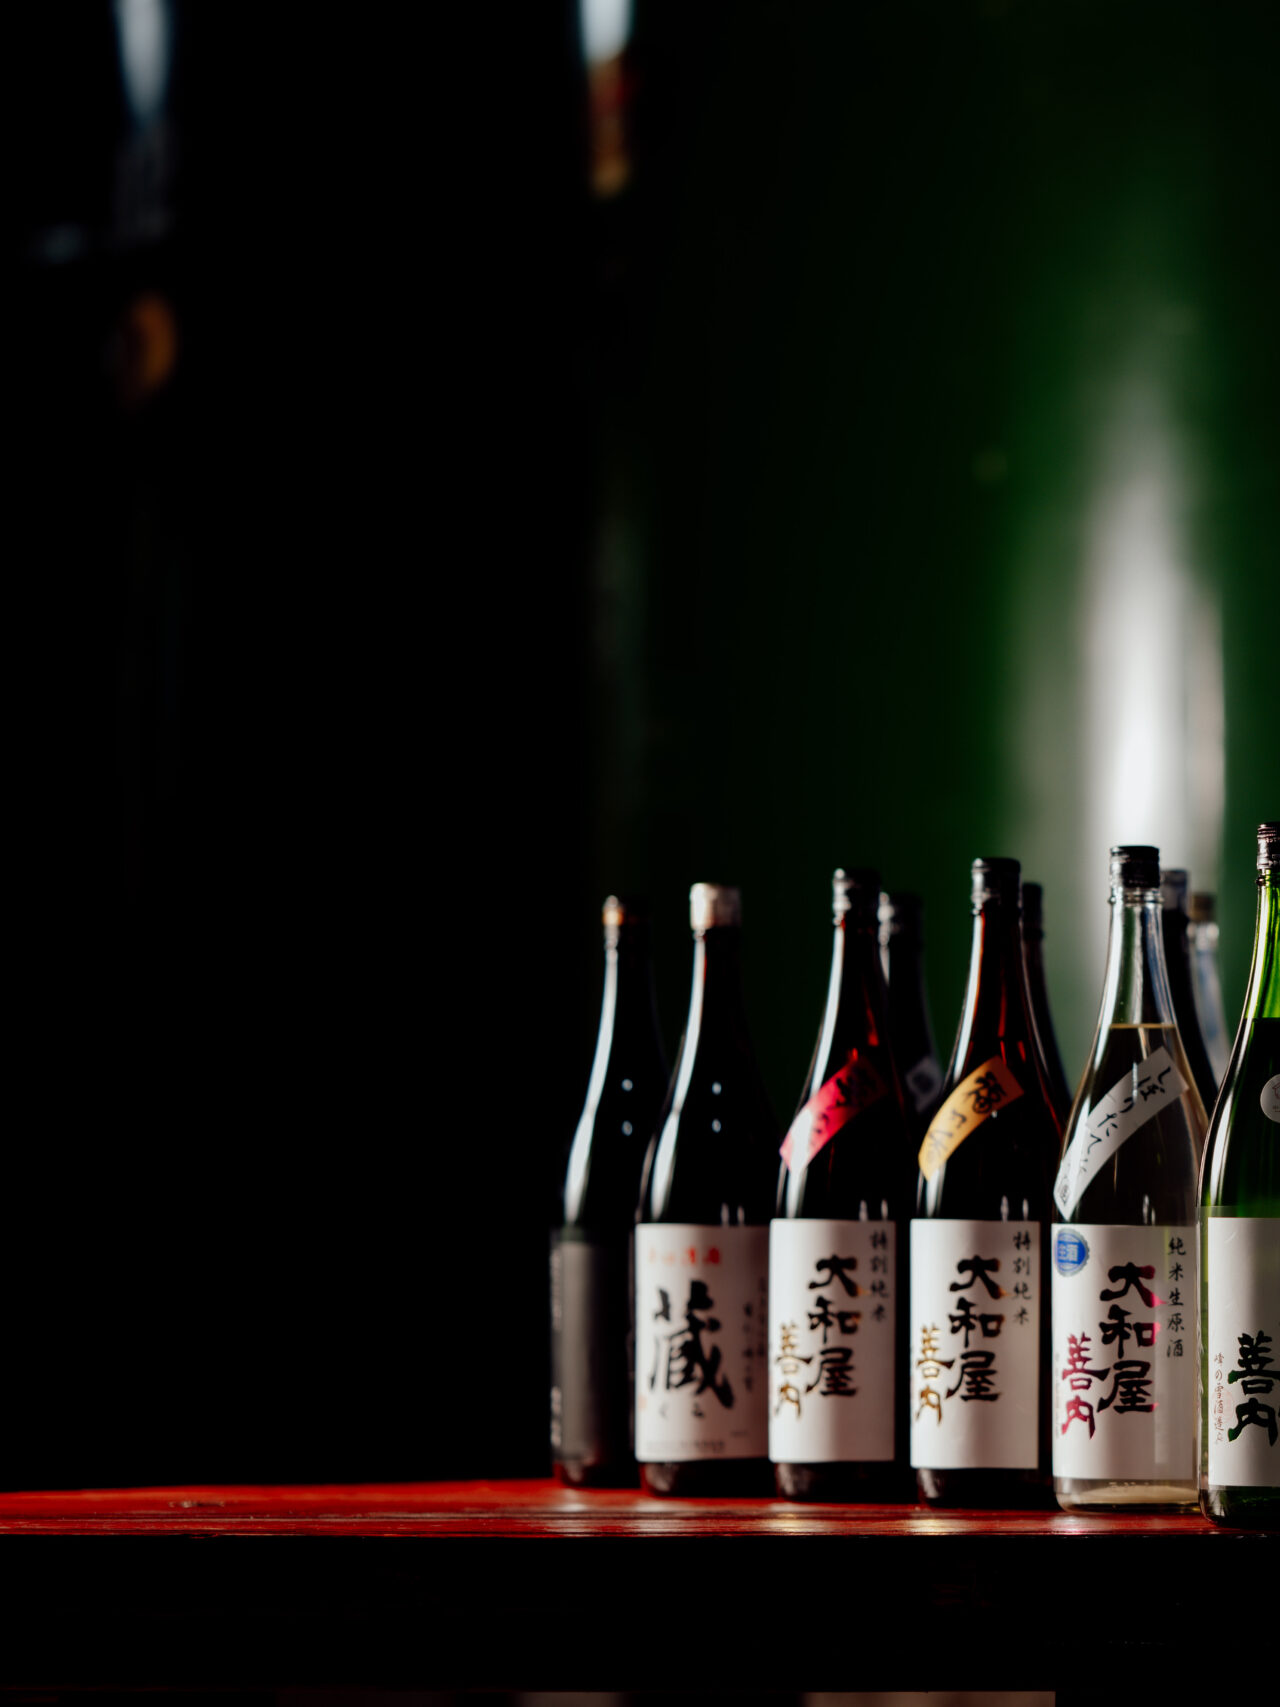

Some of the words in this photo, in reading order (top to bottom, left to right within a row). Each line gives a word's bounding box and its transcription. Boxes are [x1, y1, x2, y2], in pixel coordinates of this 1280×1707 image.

[806, 1255, 869, 1398] 大和屋
[869, 1229, 889, 1323] 特別純米
[946, 1255, 1009, 1402] 大和屋
[1012, 1230, 1033, 1326] 特別純米
[1166, 1236, 1187, 1359] 純米生原酒
[774, 1322, 812, 1421] 善内
[915, 1323, 956, 1426] 善内
[1060, 1331, 1111, 1440] 善内
[1097, 1261, 1166, 1415] 大和屋
